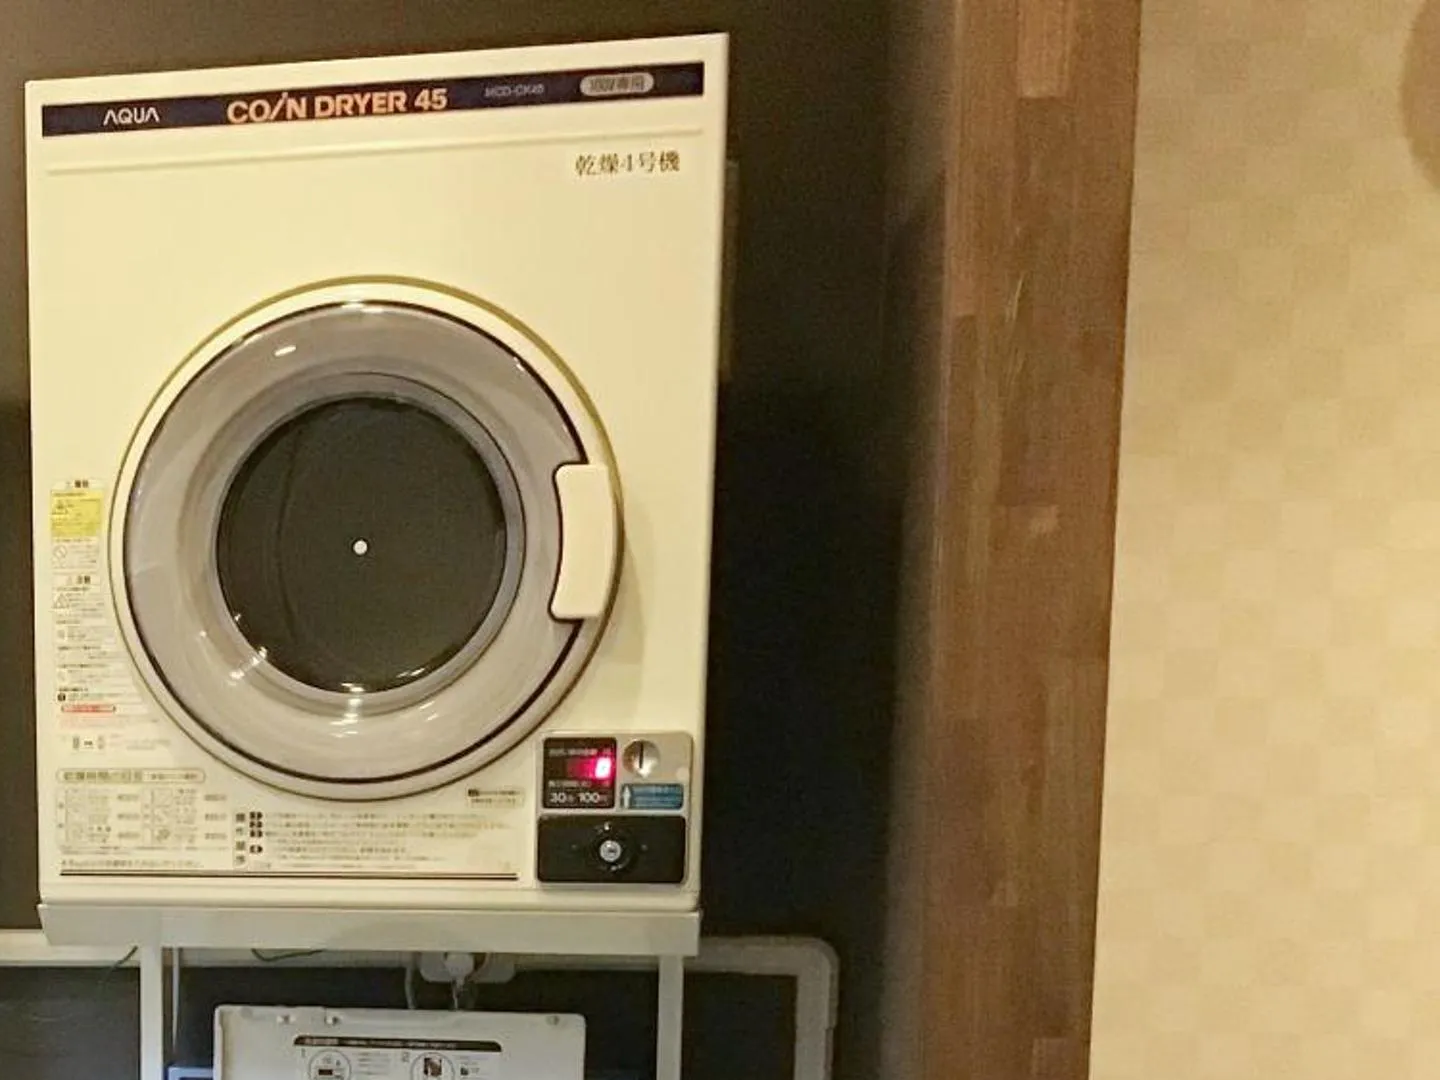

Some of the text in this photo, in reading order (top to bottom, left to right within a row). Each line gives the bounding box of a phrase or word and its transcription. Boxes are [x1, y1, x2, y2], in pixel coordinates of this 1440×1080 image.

[102, 106, 160, 126] AQUA
[314, 91, 407, 119] DRYER
[413, 88, 449, 111] 45
